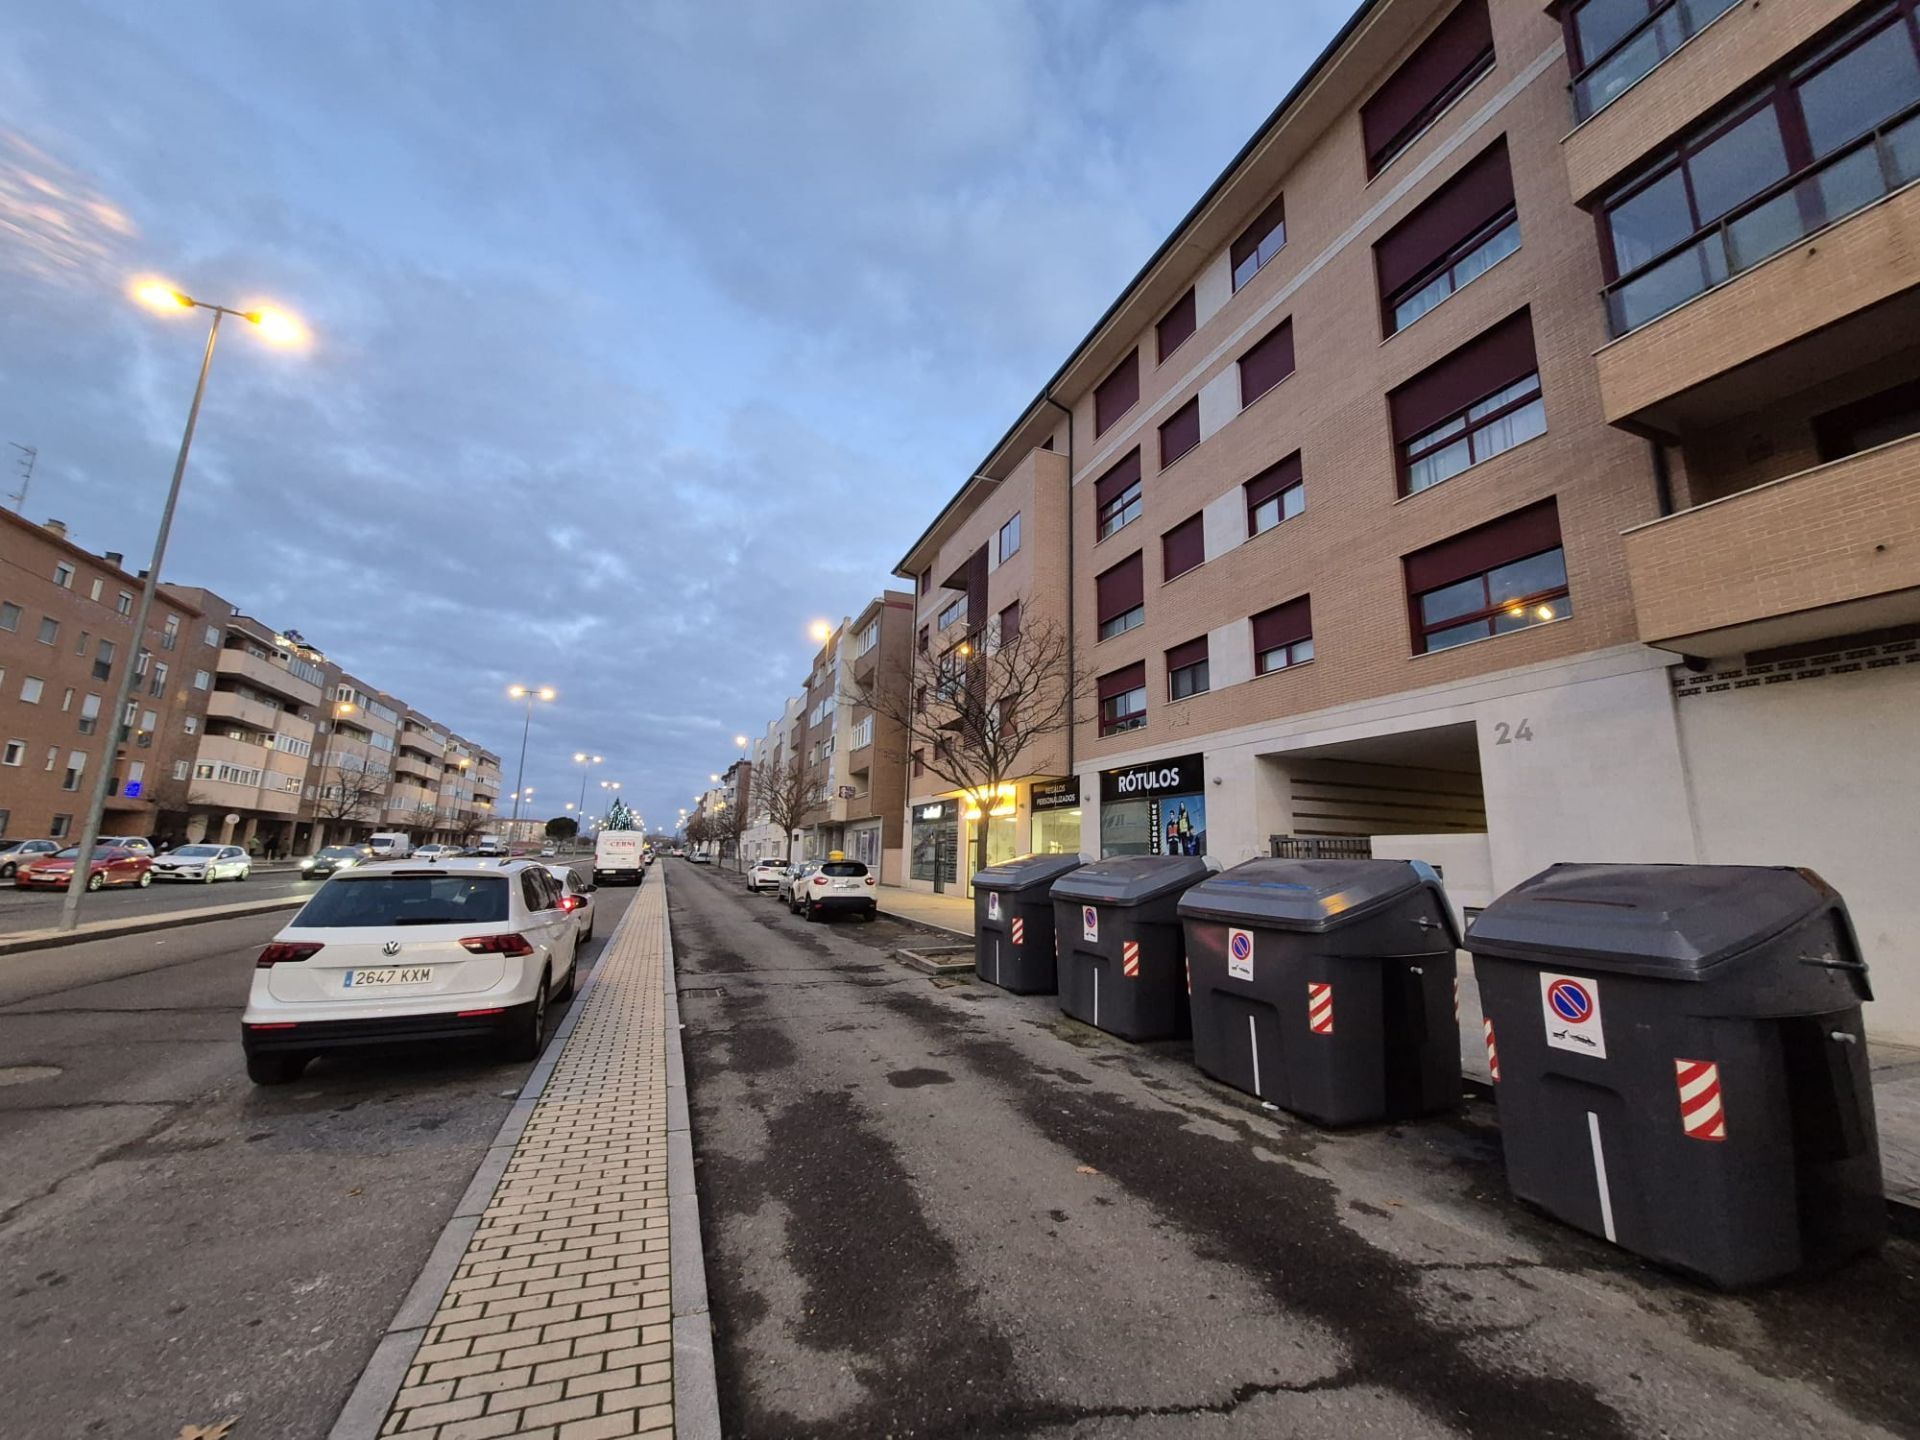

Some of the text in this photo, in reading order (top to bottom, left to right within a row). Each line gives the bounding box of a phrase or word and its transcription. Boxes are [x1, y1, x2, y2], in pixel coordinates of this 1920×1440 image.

[1494, 718, 1533, 745] 24
[1118, 767, 1180, 793] RÓTULOS
[356, 969, 431, 984] 2647 KXM
